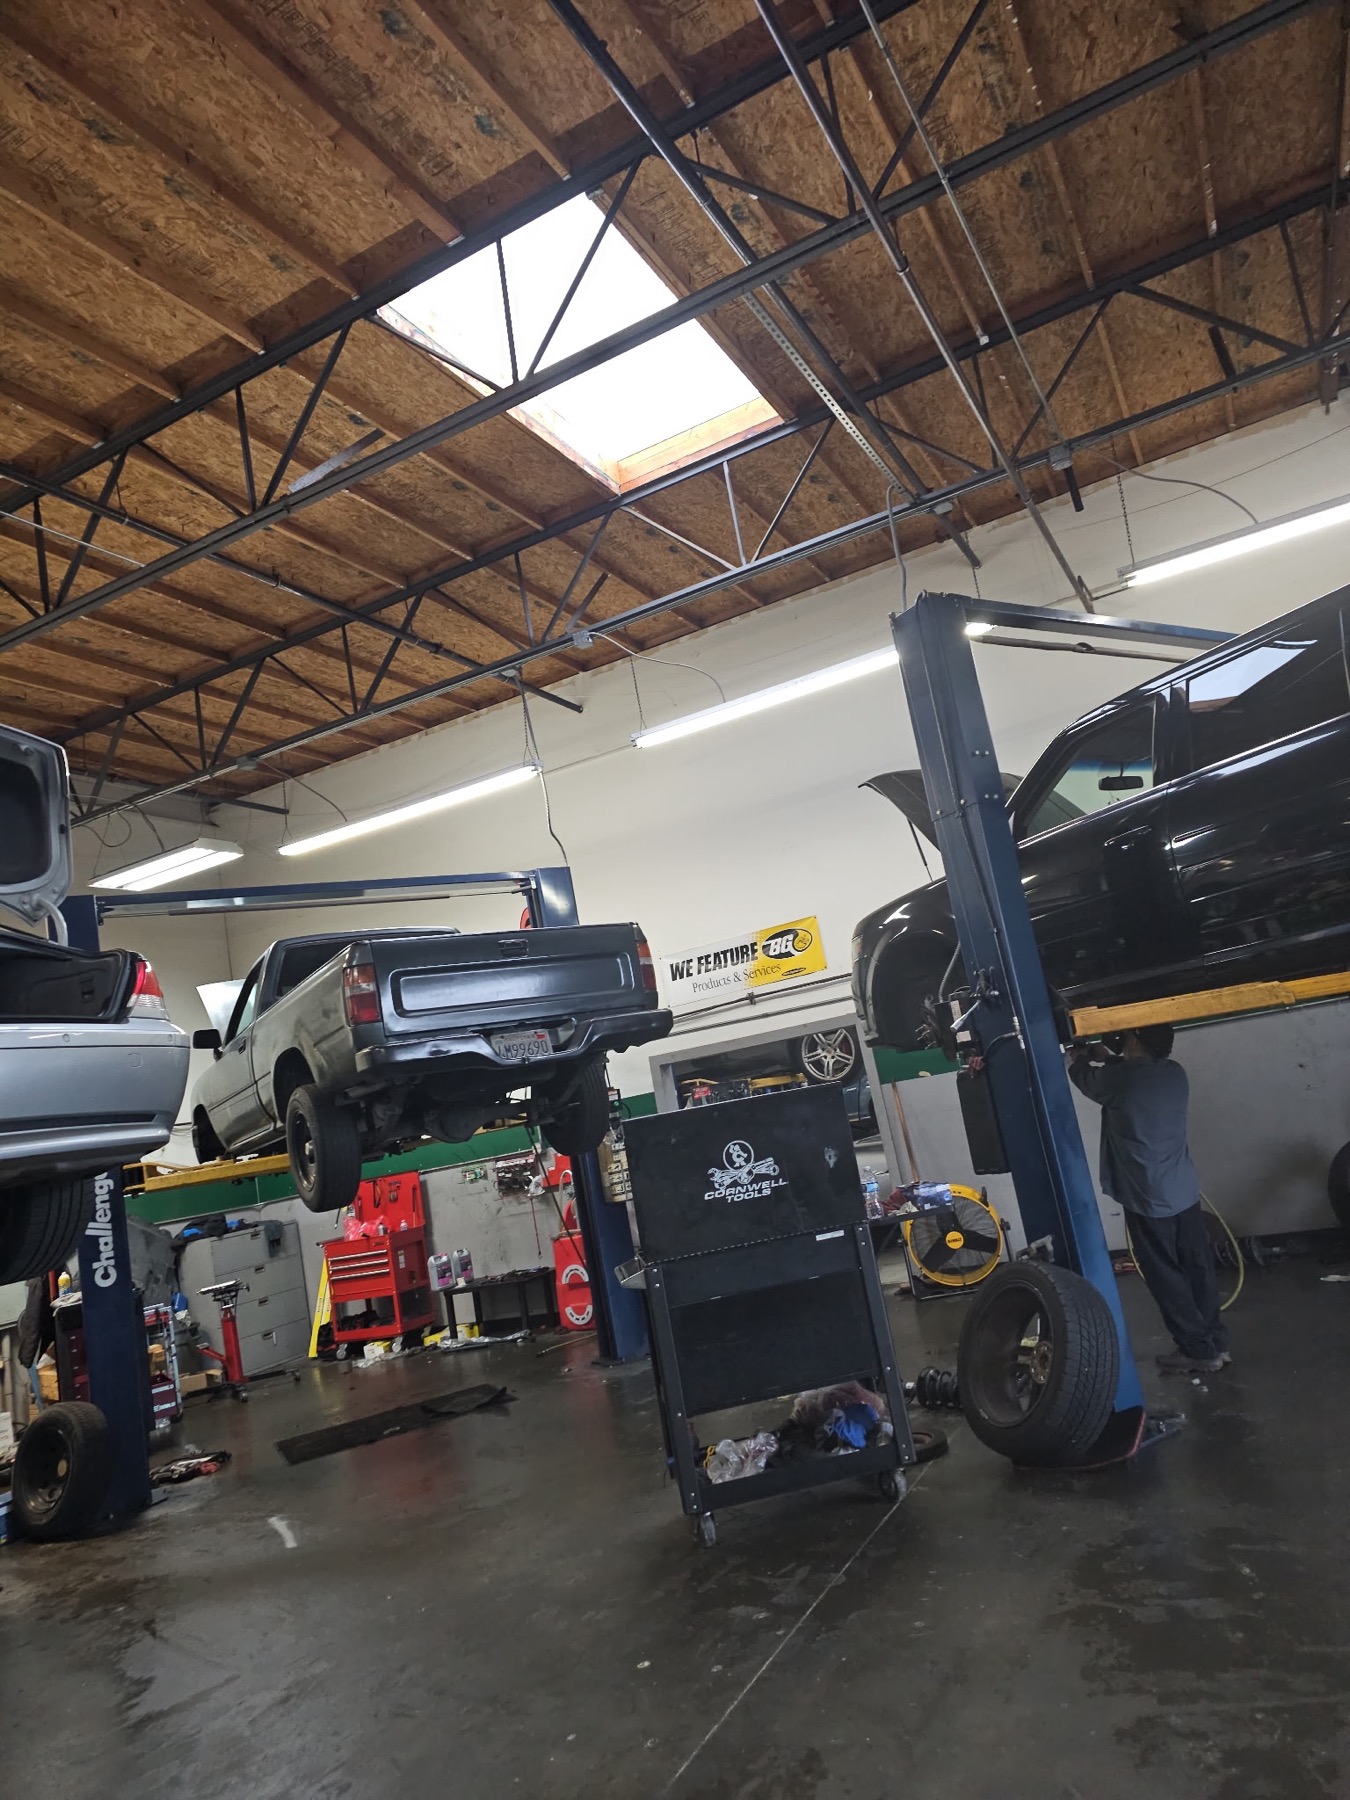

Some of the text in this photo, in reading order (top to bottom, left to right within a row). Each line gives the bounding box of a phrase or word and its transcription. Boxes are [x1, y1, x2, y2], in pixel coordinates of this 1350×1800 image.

[764, 933, 794, 956] BG
[669, 941, 759, 982] WE FEATURE
[692, 975, 732, 993] Products
[733, 972, 743, 982] &
[743, 963, 782, 980] Services
[704, 1178, 788, 1201] CORNWELL
[725, 1188, 772, 1203] TOOLS
